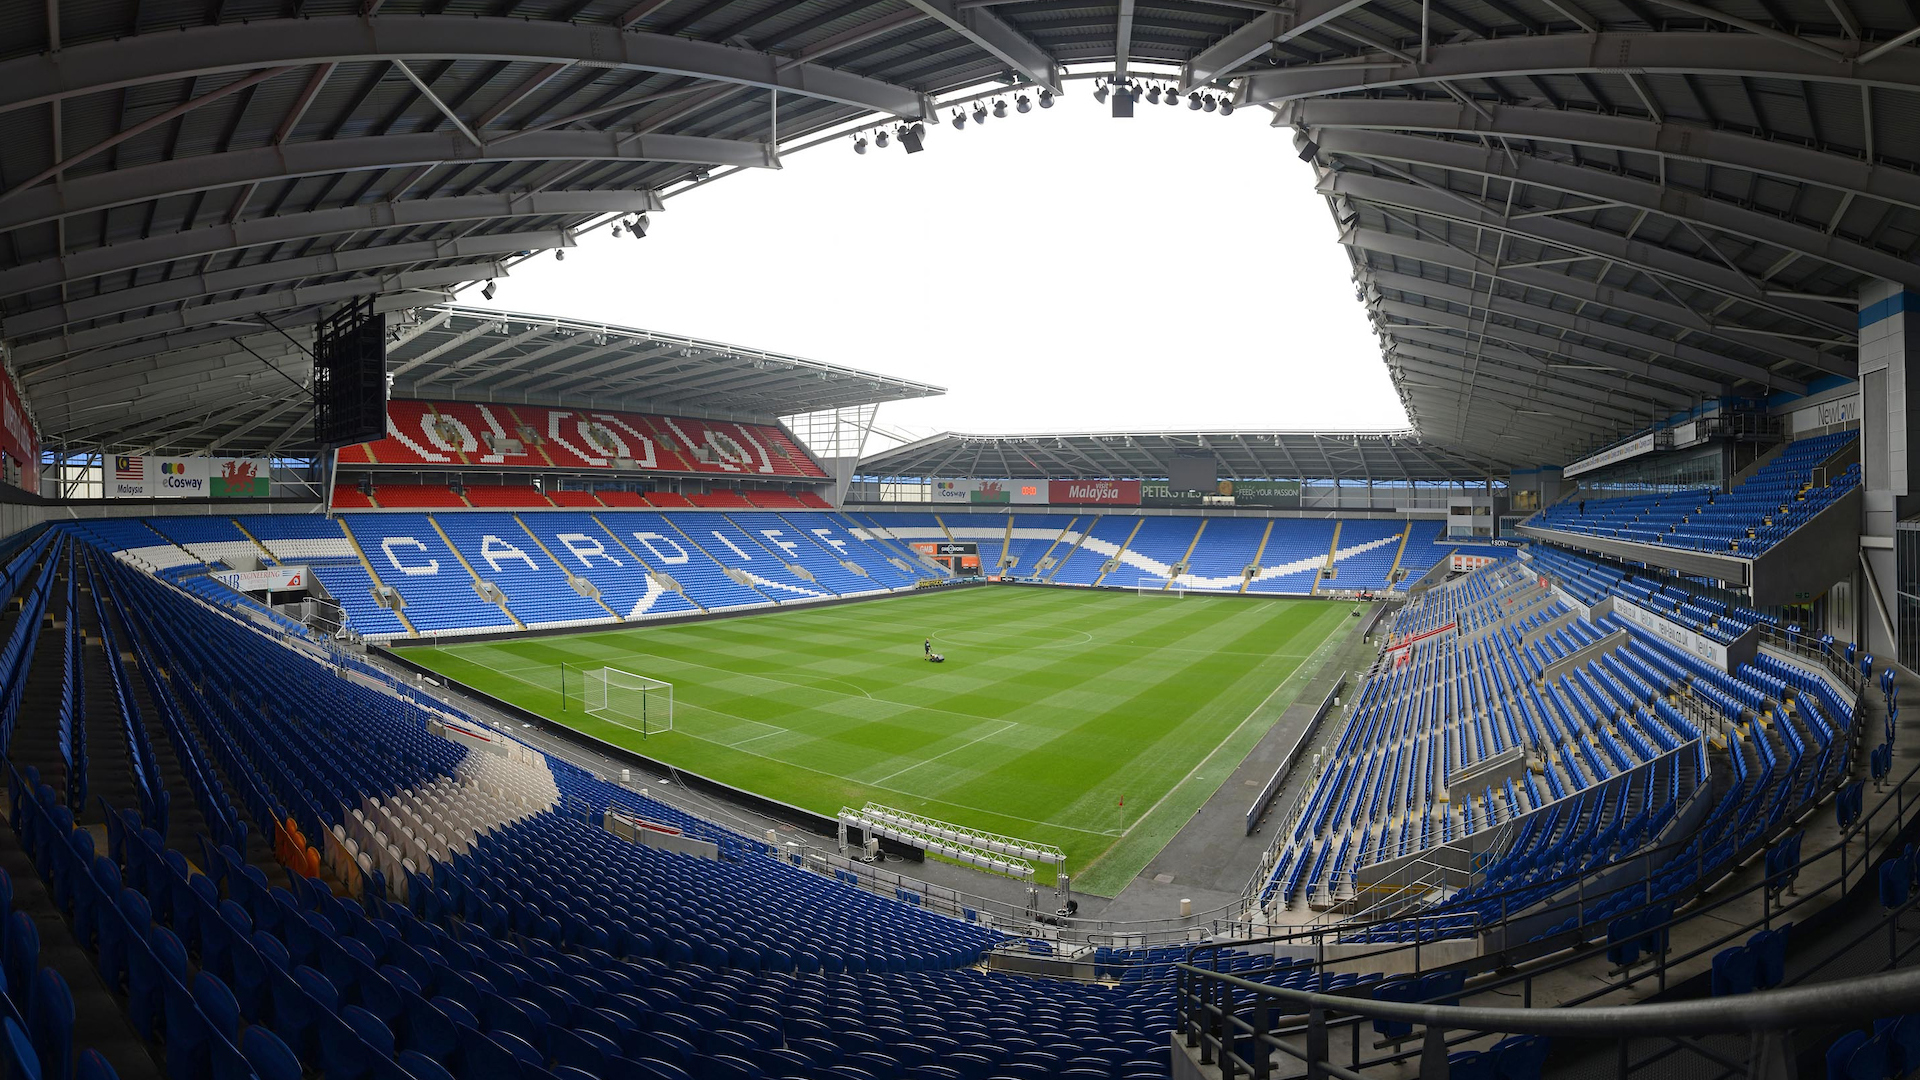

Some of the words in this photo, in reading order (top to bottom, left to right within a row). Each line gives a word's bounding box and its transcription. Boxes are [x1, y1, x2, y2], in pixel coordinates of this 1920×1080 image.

[1818, 401, 1856, 426] NewLaw
[117, 484, 143, 495] Malaysia
[162, 476, 203, 490] eCosway
[1069, 485, 1119, 501] Malaysia
[1239, 488, 1253, 496] FEED
[381, 528, 848, 576] CARDIFF
[240, 571, 280, 581] ENGINEERING
